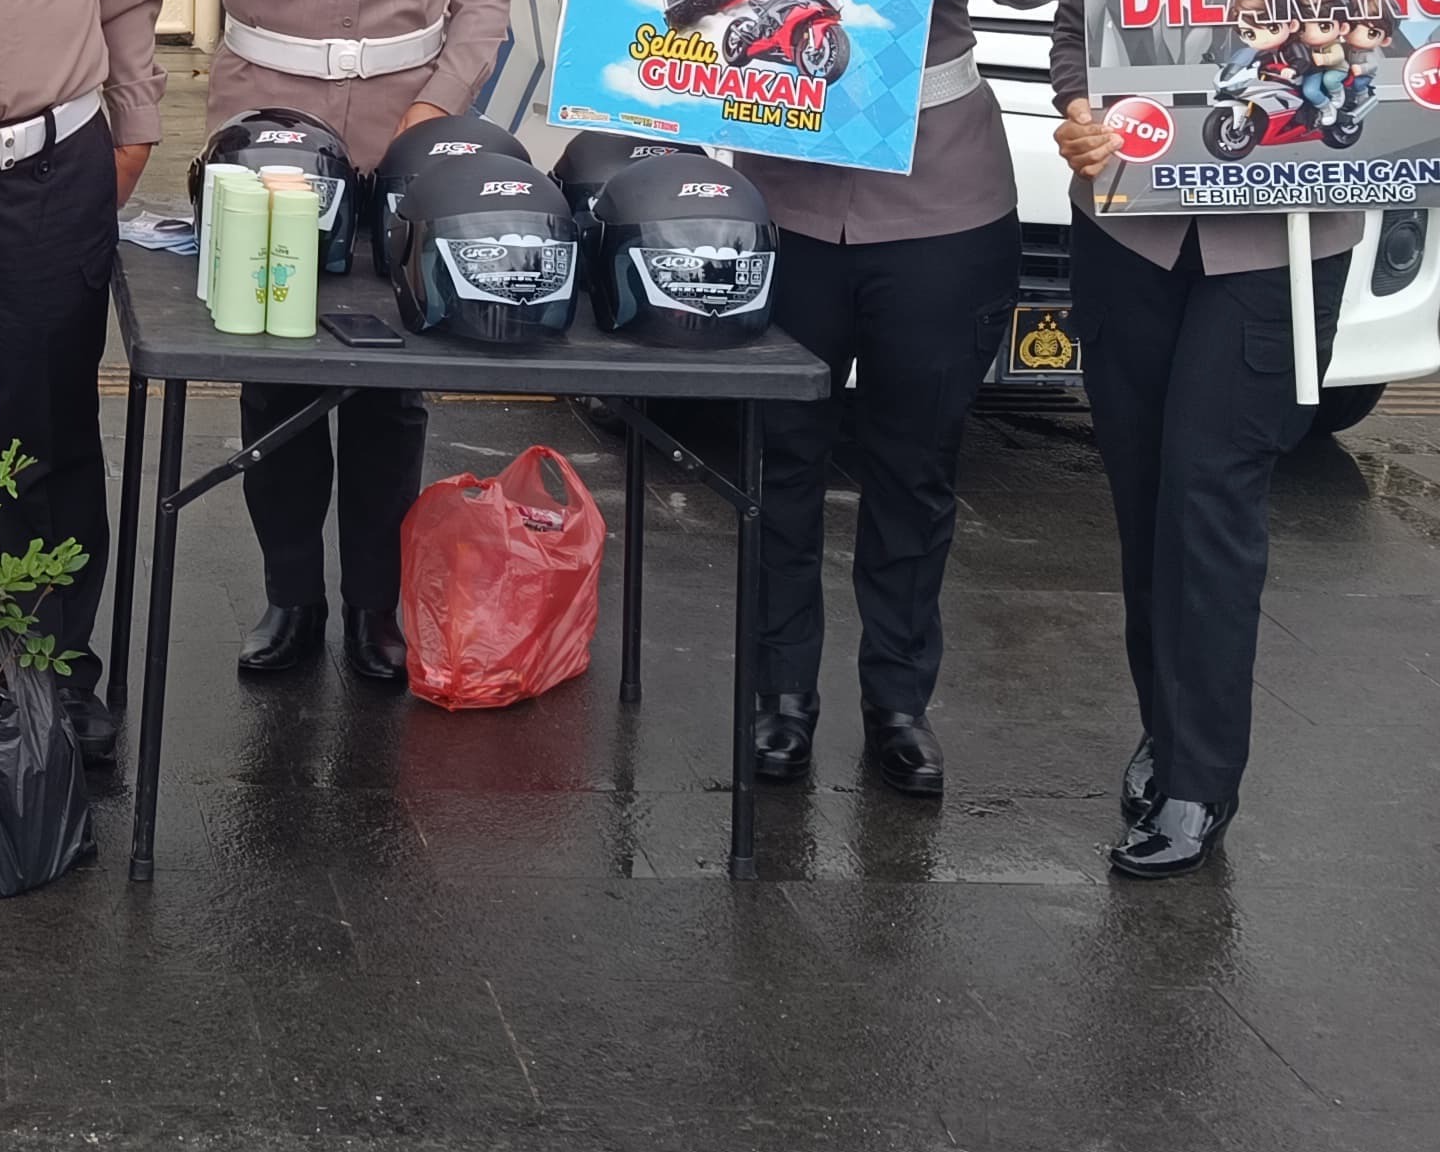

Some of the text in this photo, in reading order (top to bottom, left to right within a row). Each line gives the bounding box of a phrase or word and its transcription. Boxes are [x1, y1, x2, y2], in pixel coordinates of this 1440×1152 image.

[630, 24, 717, 64] Selalu
[640, 57, 827, 111] GUNAKAN
[723, 102, 822, 132] HELM SNI
[1110, 112, 1169, 144] STOP
[1153, 160, 1440, 187] BERBONCENGAN
[1182, 185, 1416, 205] LEBIH DARI 1 ORANG
